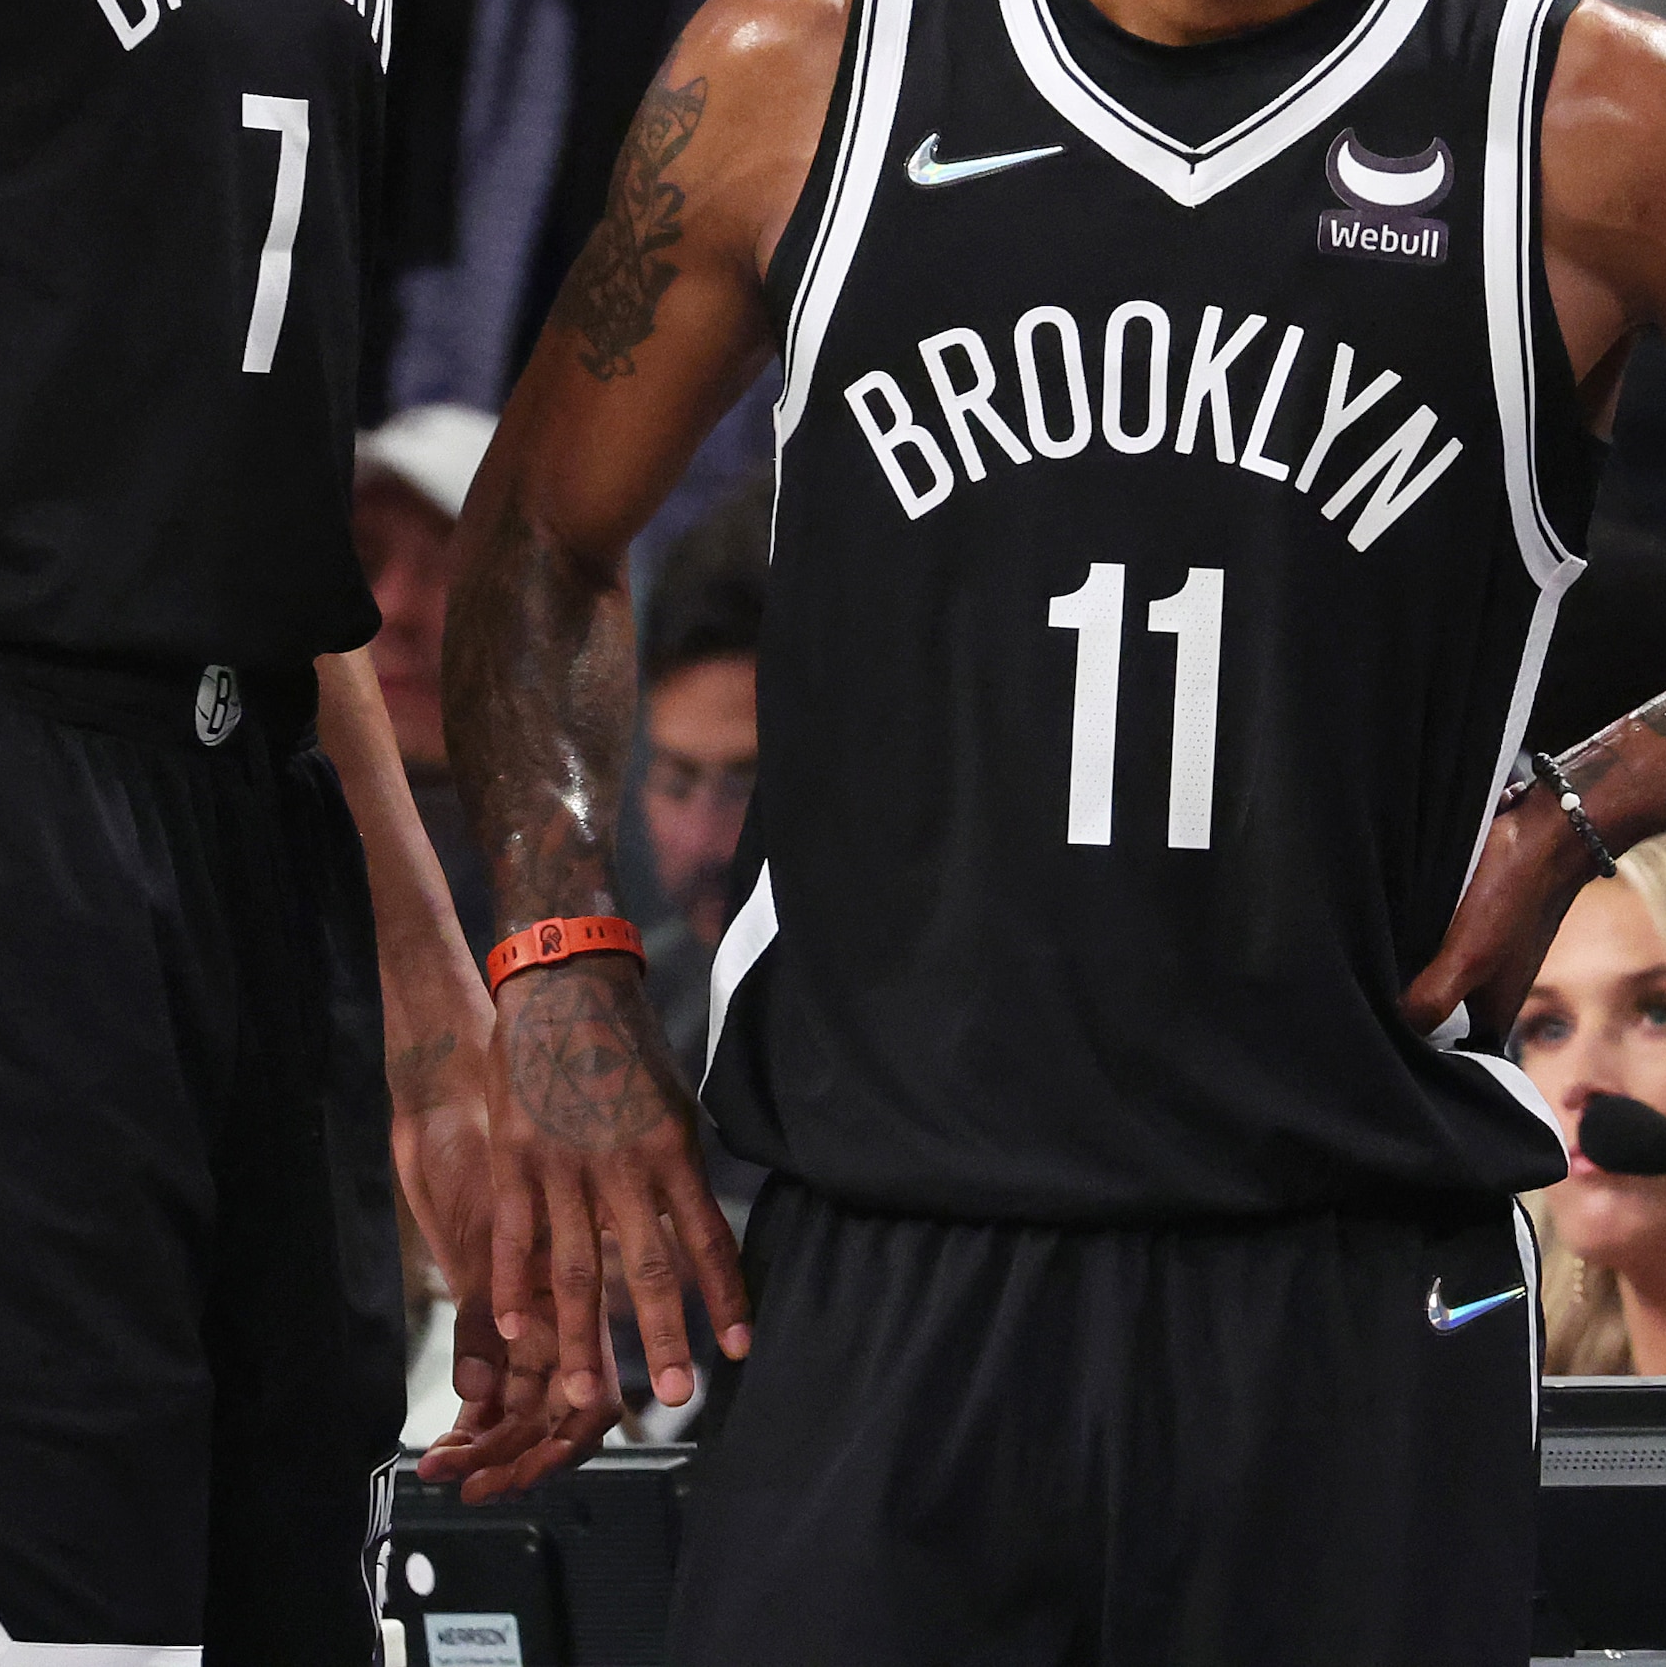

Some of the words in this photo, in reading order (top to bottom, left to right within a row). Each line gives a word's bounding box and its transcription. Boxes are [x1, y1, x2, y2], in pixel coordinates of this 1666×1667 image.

[241, 92, 311, 374] 7
[1330, 219, 1440, 259] Webull
[842, 299, 1464, 554] BROOKLYN
[1046, 561, 1225, 851] 11
